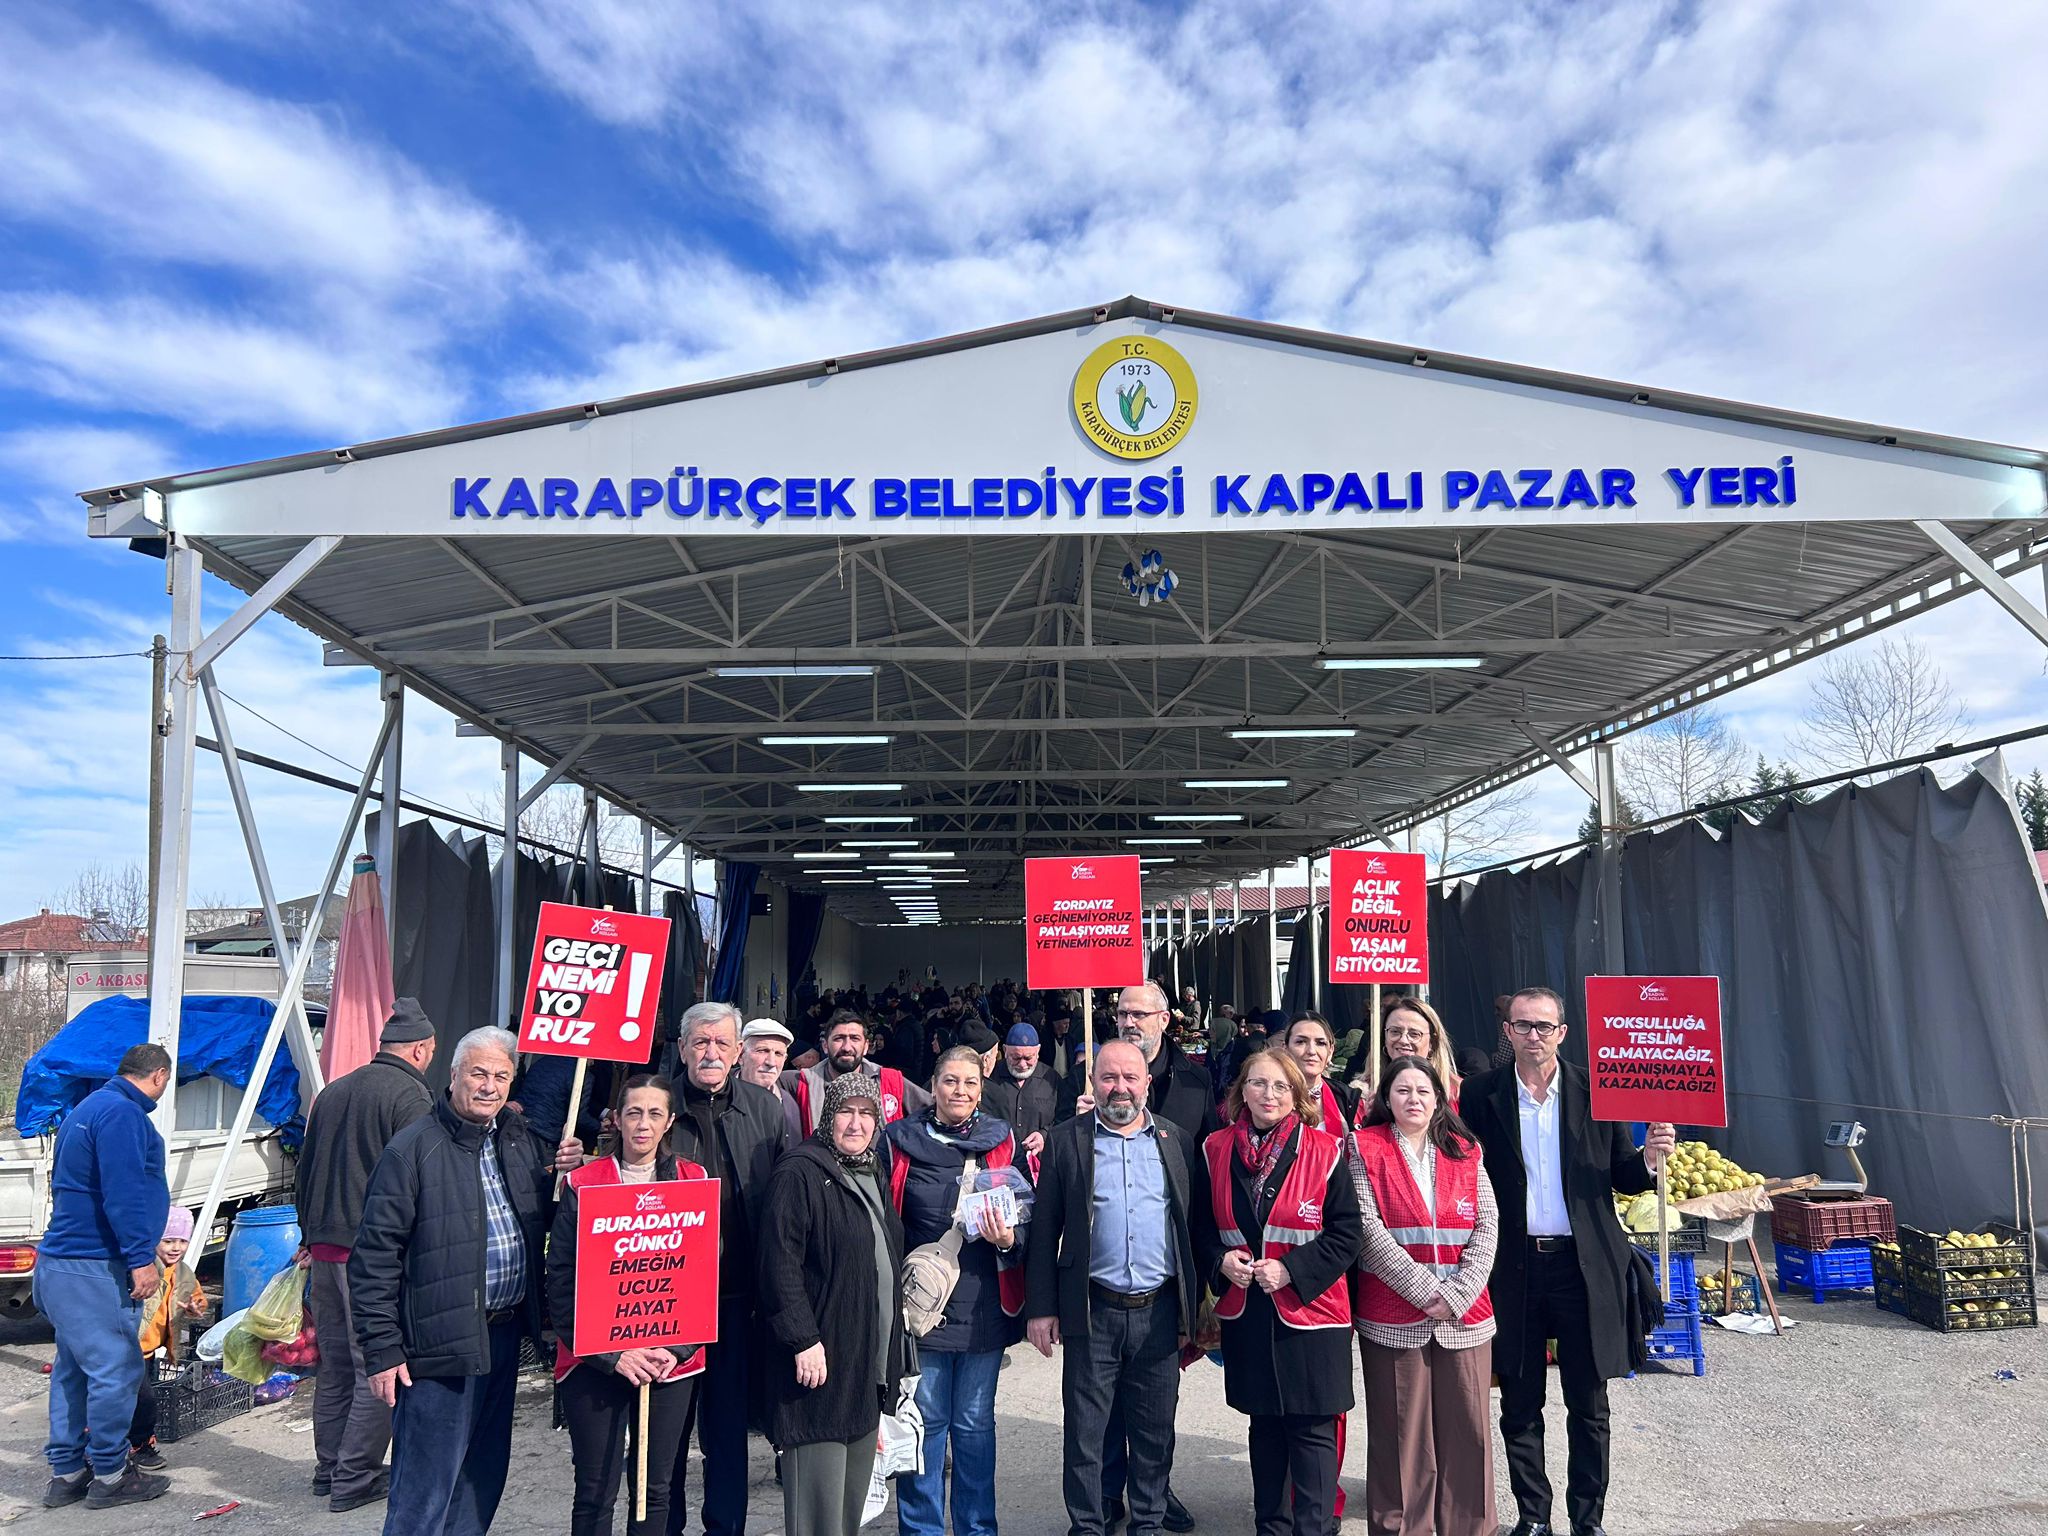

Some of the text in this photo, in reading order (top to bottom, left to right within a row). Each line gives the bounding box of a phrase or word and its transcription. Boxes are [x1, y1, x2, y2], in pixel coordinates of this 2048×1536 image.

[1122, 343, 1149, 356] T.C.
[1120, 364, 1151, 376] 1973
[1081, 400, 1192, 453] KARAPÜRÇEK BELEDİYESİ
[453, 455, 1797, 525] KARAPÜRÇEK BELEDİYESİ KAPALI PAZAR YERİ
[1352, 879, 1401, 898] AÇLIK
[1053, 899, 1114, 911] ZORDAYIZ
[1351, 896, 1402, 917] DEĞİL,
[1033, 911, 1134, 926] GEÇİNEMİYORUZ,
[1345, 918, 1411, 934] ONURLU
[1039, 925, 1130, 938] PAYLAŞIYORUZ
[1036, 936, 1134, 950] YETİNEMİYORUZ.
[1350, 937, 1407, 955] YAŞAM
[543, 938, 621, 969] GEÇİ
[1335, 955, 1422, 973] İSTİYORUZ.
[537, 963, 619, 995] NEMİ
[538, 990, 582, 1017] YO
[527, 1017, 596, 1045] RUZ
[1603, 1015, 1706, 1030] YOKSULLUĞA
[1628, 1030, 1684, 1045] TESLİM
[1598, 1046, 1714, 1064] OLMAYACAĞIZ,
[1596, 1062, 1716, 1078] DAYANIŞMAYLA
[1598, 1077, 1716, 1093] KAZANACAĞIZ!
[591, 1210, 706, 1235] BURADAYIM
[614, 1230, 684, 1258] ÇÜNKÜ
[609, 1252, 686, 1276] EMEĞİM
[618, 1278, 675, 1296] UCUZ,
[615, 1298, 678, 1318] HAYAT
[609, 1320, 681, 1342] PAHALI.
